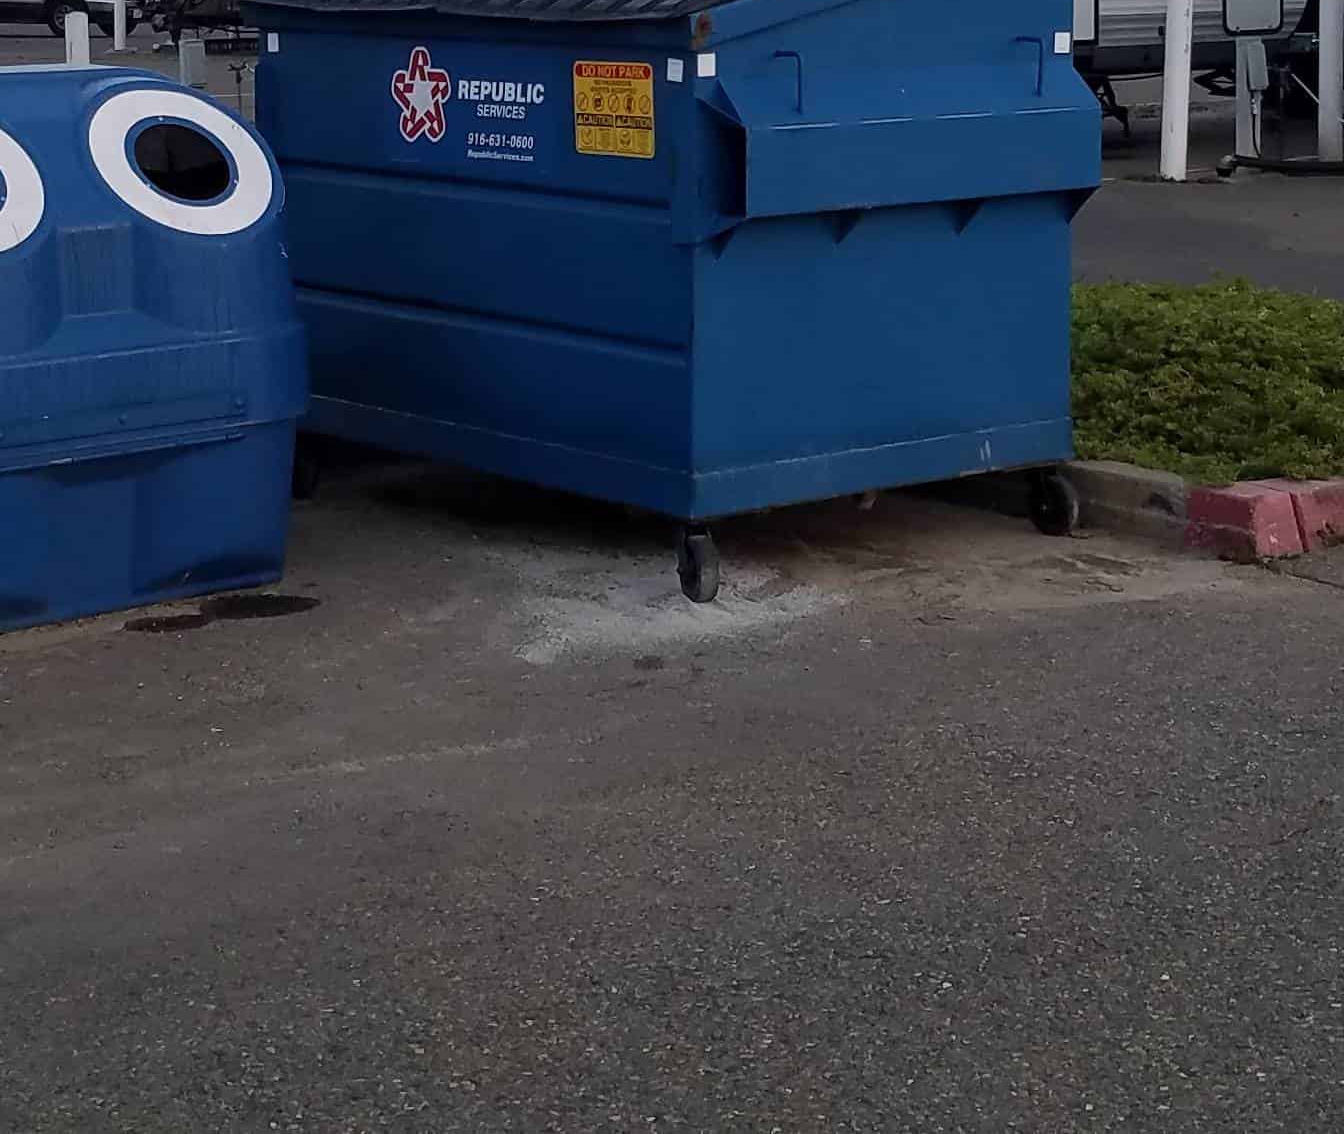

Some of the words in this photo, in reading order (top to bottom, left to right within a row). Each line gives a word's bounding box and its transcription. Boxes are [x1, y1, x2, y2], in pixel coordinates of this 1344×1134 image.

[582, 65, 596, 76] DO
[597, 65, 616, 77] NOT
[619, 66, 646, 78] PARK
[458, 80, 544, 104] REPUBLIC
[477, 104, 526, 119] SERVICES
[468, 132, 534, 149] 916-631-0600
